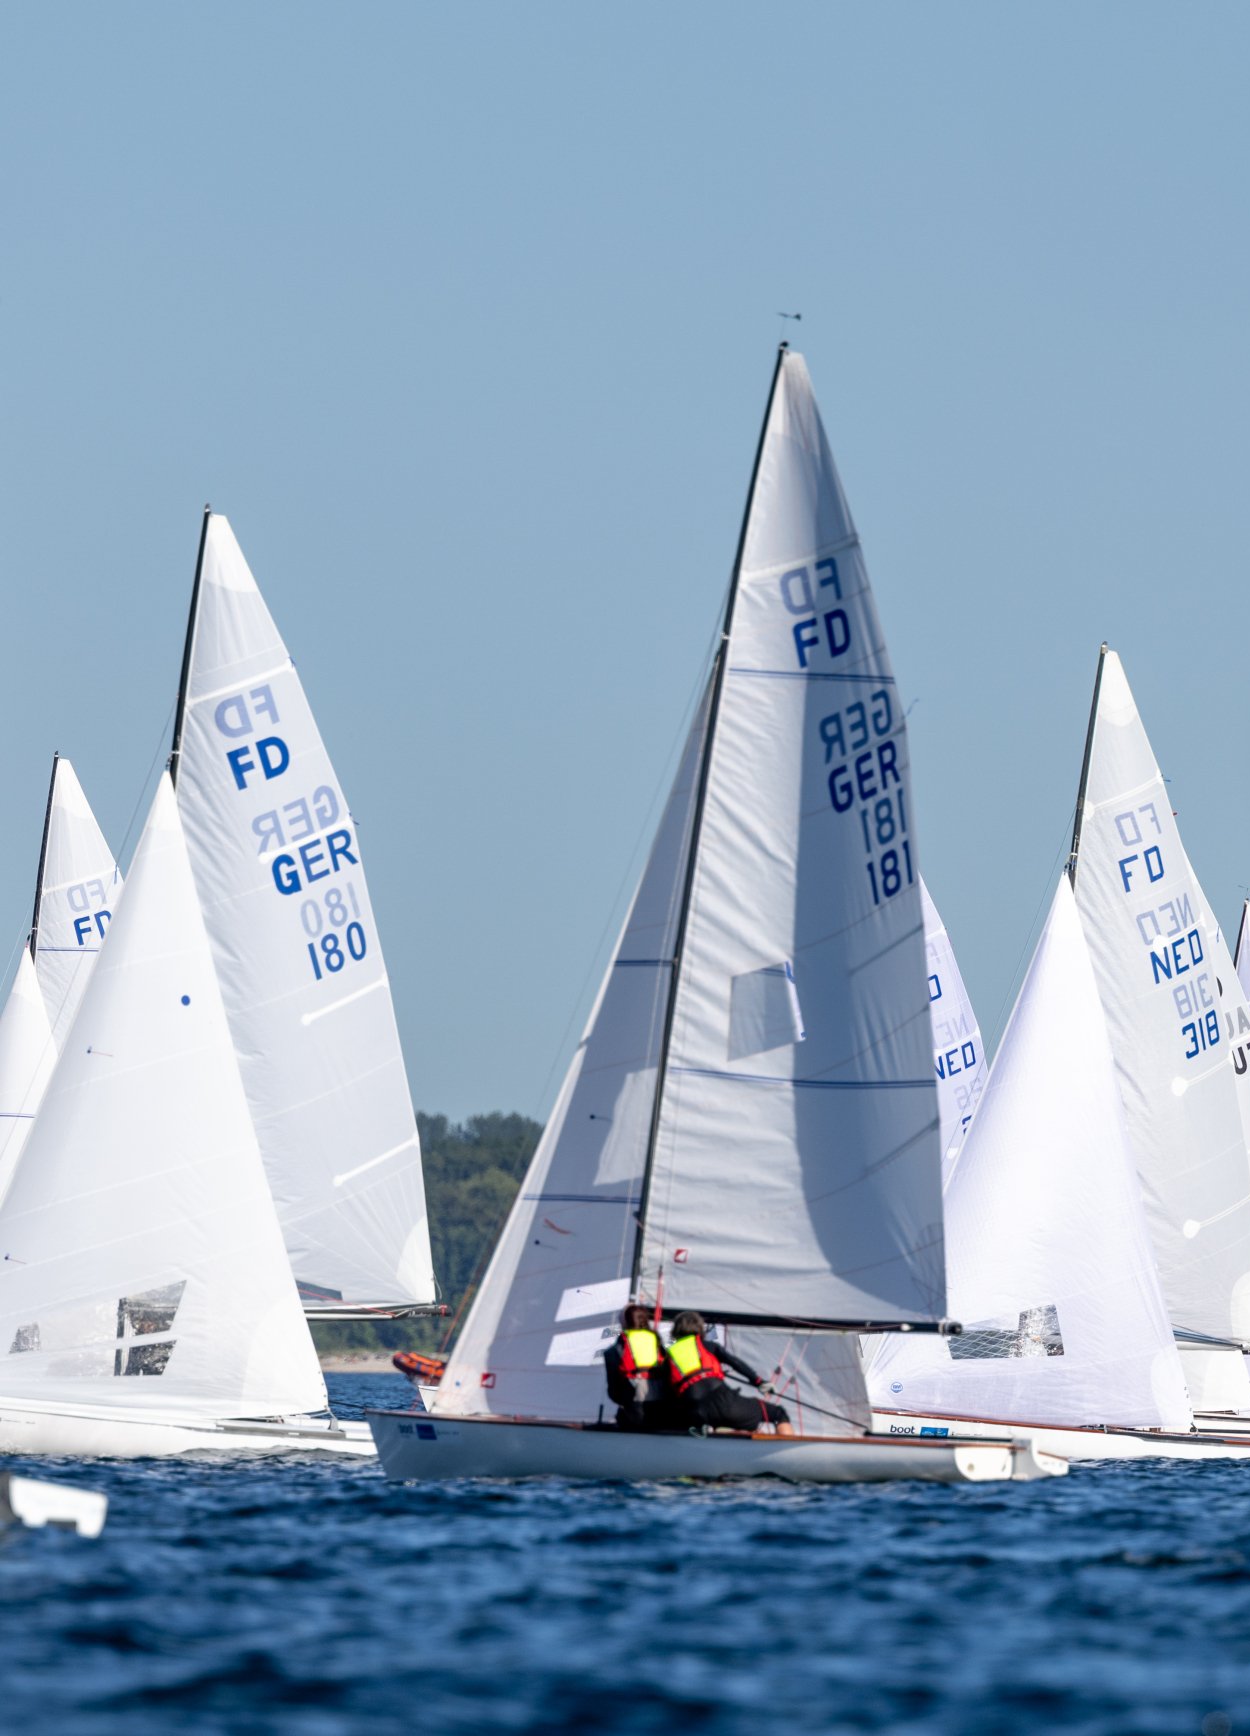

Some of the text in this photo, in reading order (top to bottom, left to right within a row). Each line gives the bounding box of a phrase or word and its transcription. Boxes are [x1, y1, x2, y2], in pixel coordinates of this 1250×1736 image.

[792, 608, 851, 668] FD
[226, 736, 290, 790] FD
[828, 740, 900, 813] GER
[271, 828, 359, 895] GER
[866, 841, 913, 905] 181
[1118, 846, 1164, 892] FD
[307, 921, 367, 980] 180
[1150, 929, 1203, 984] NED
[1181, 1010, 1220, 1059] 318
[889, 1424, 915, 1434] boot
